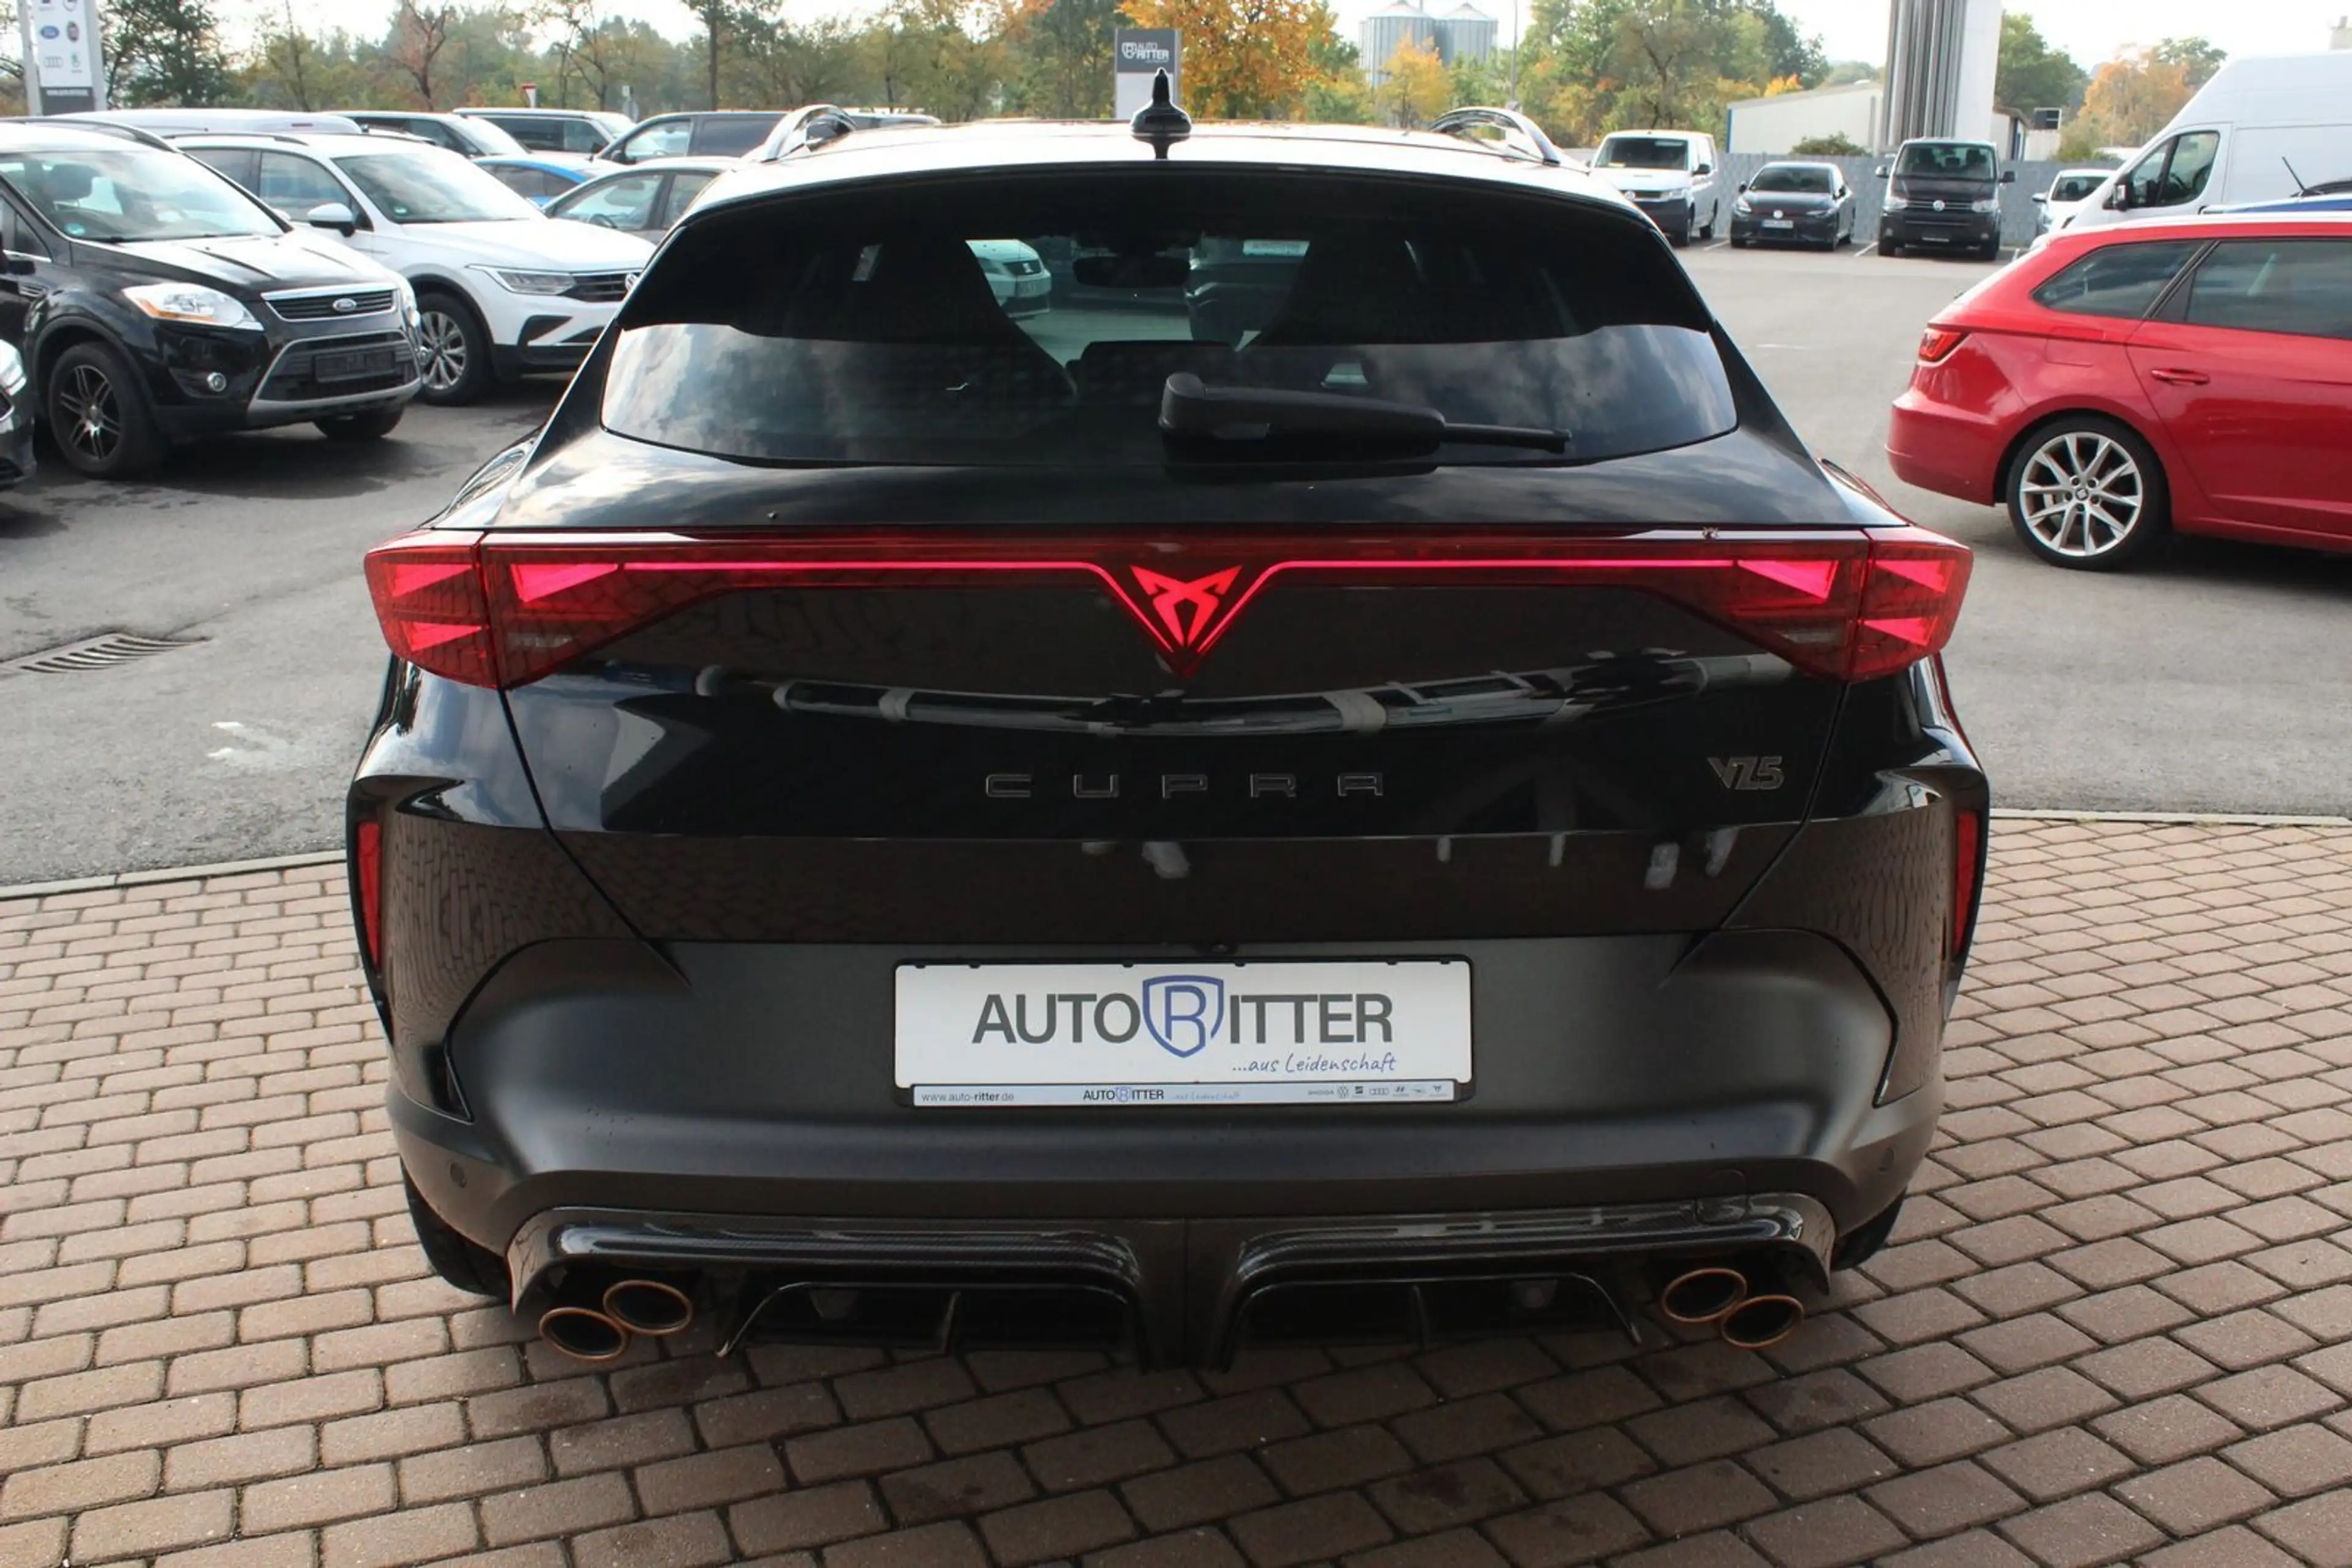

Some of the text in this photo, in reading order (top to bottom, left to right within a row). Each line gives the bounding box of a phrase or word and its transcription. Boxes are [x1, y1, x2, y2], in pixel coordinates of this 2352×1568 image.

[1136, 49, 1169, 60] RITTER
[986, 773, 1384, 798] CUPRA
[1286, 1051, 1396, 1072] Leidenschaft
[921, 1090, 1014, 1102] www.auto-ritter.de
